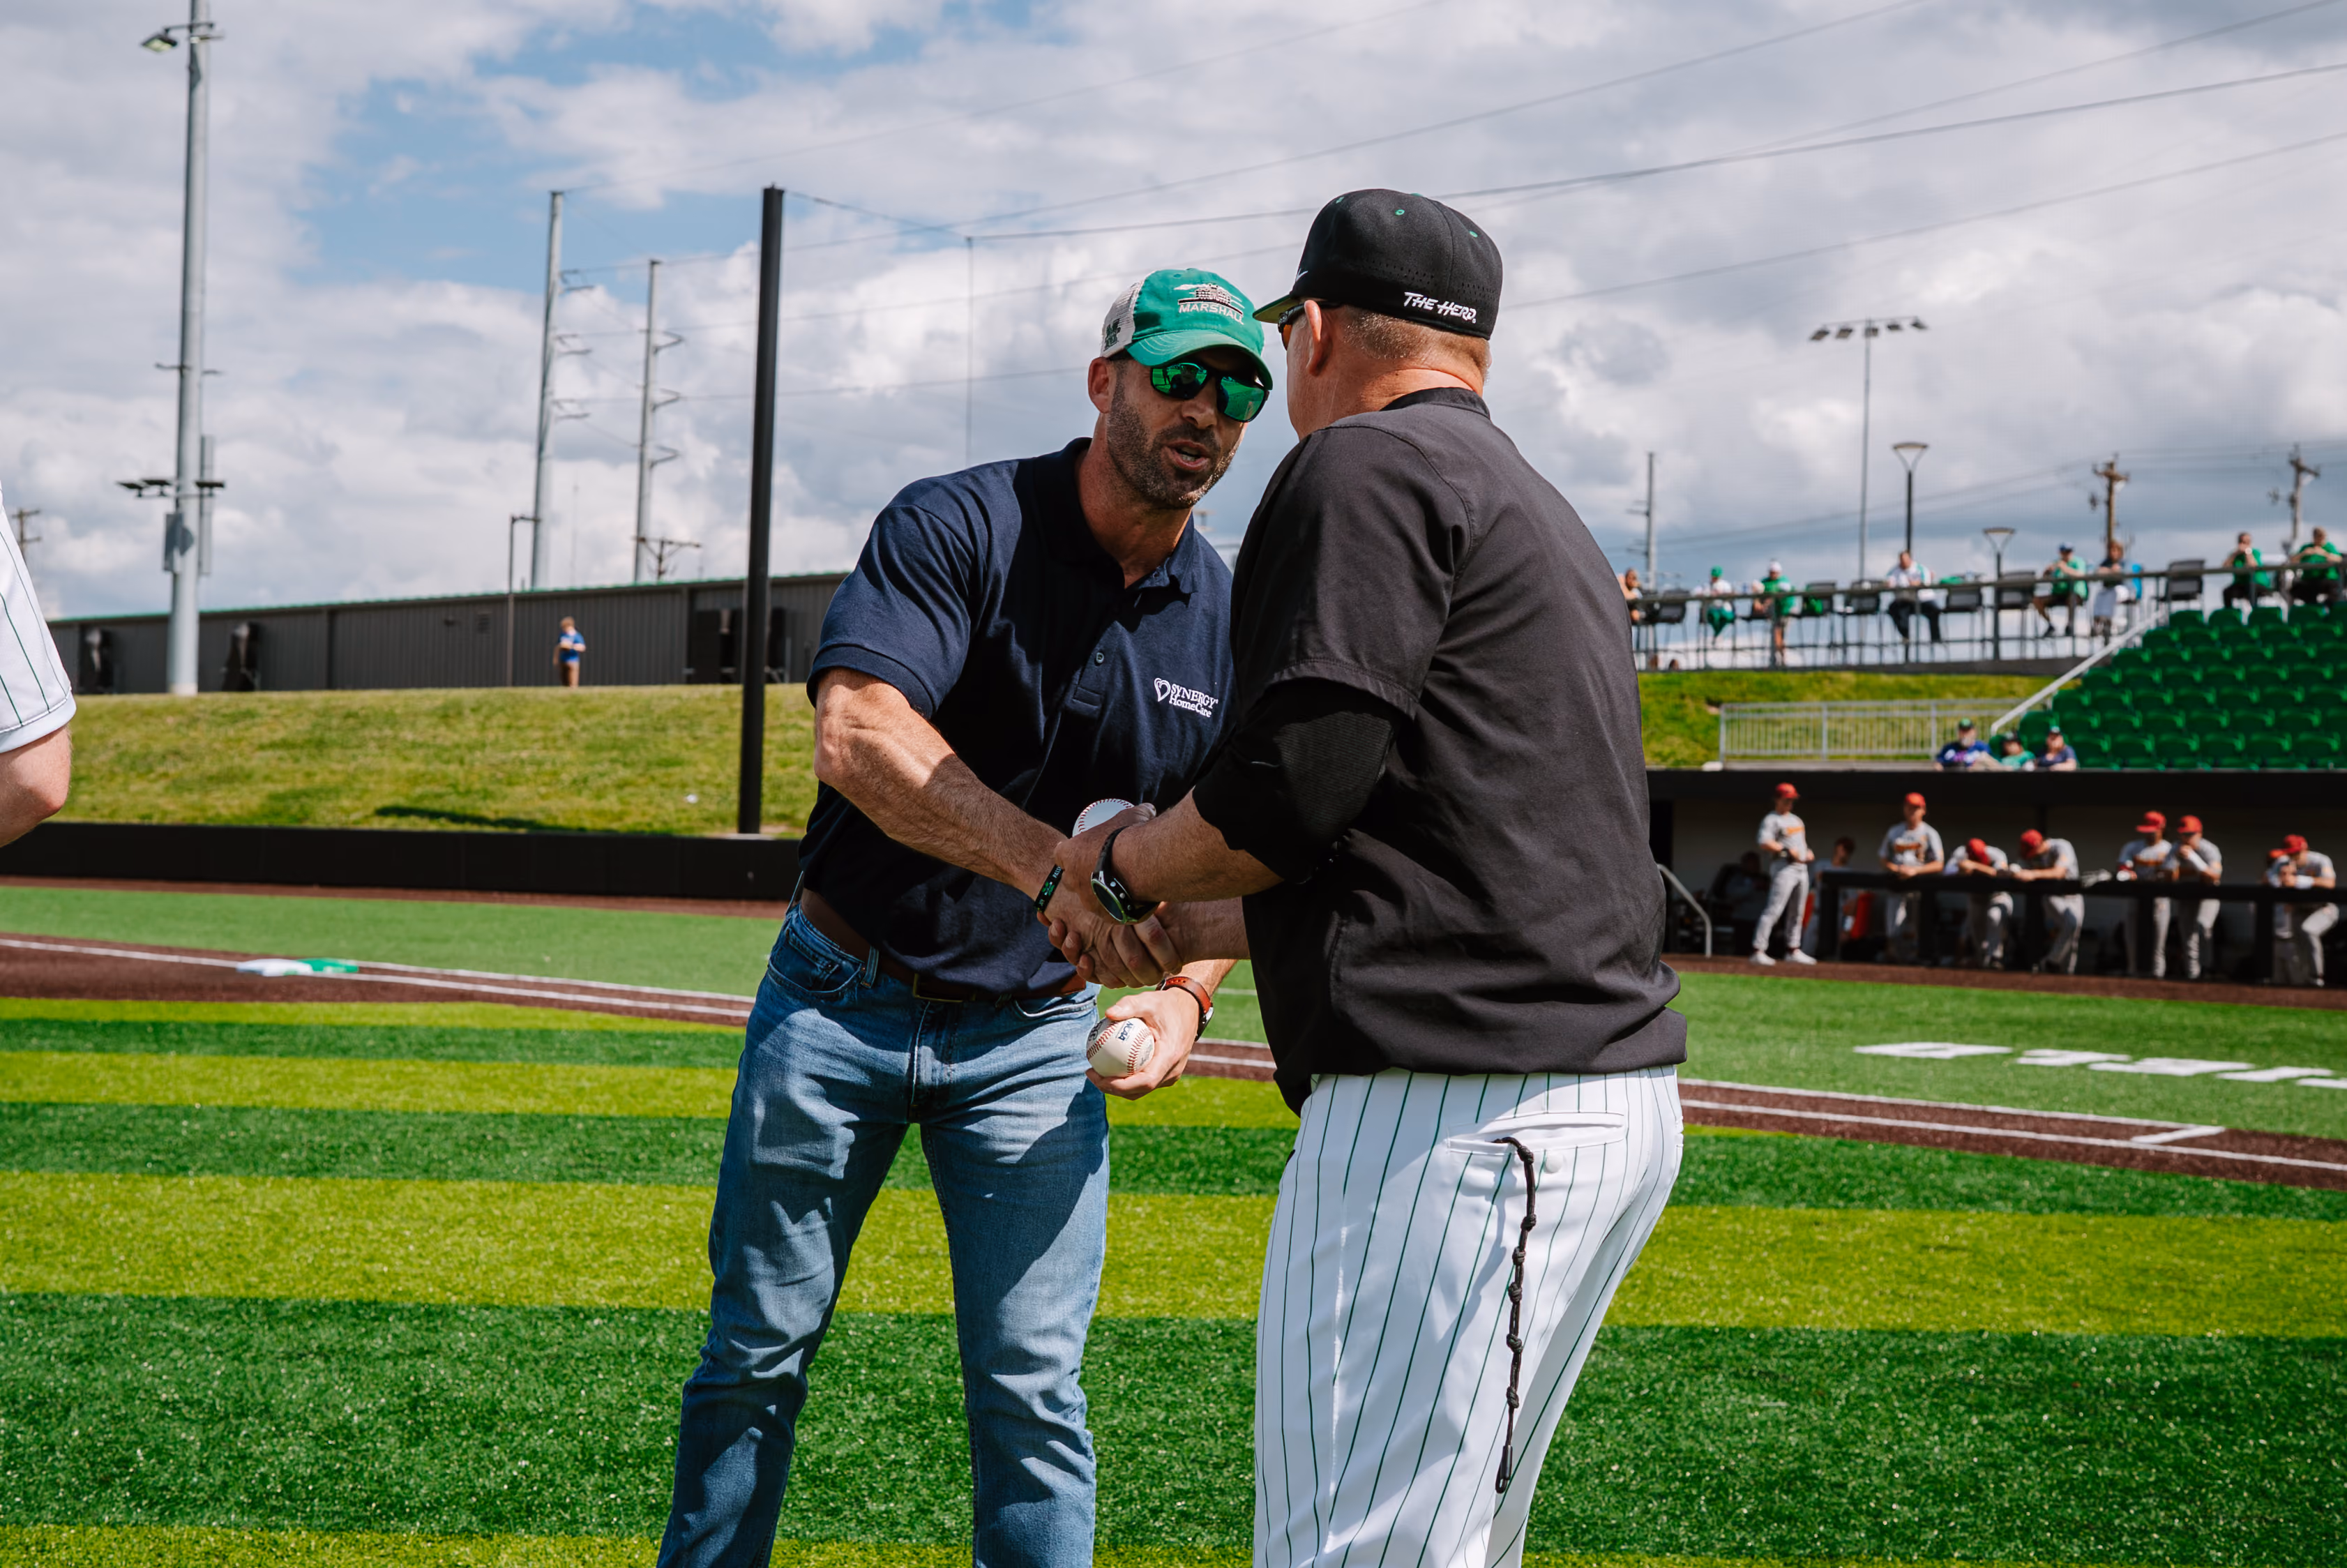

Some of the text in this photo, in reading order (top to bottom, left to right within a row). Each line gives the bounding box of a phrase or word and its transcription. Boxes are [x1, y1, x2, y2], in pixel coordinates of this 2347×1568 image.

[1178, 303, 1244, 325] MARSHALL
[1403, 292, 1477, 321] THE HERD
[1169, 693, 1212, 718] HomeCare
[1170, 684, 1216, 709] SYNERGY
[1118, 1021, 1133, 1041] NCAA
